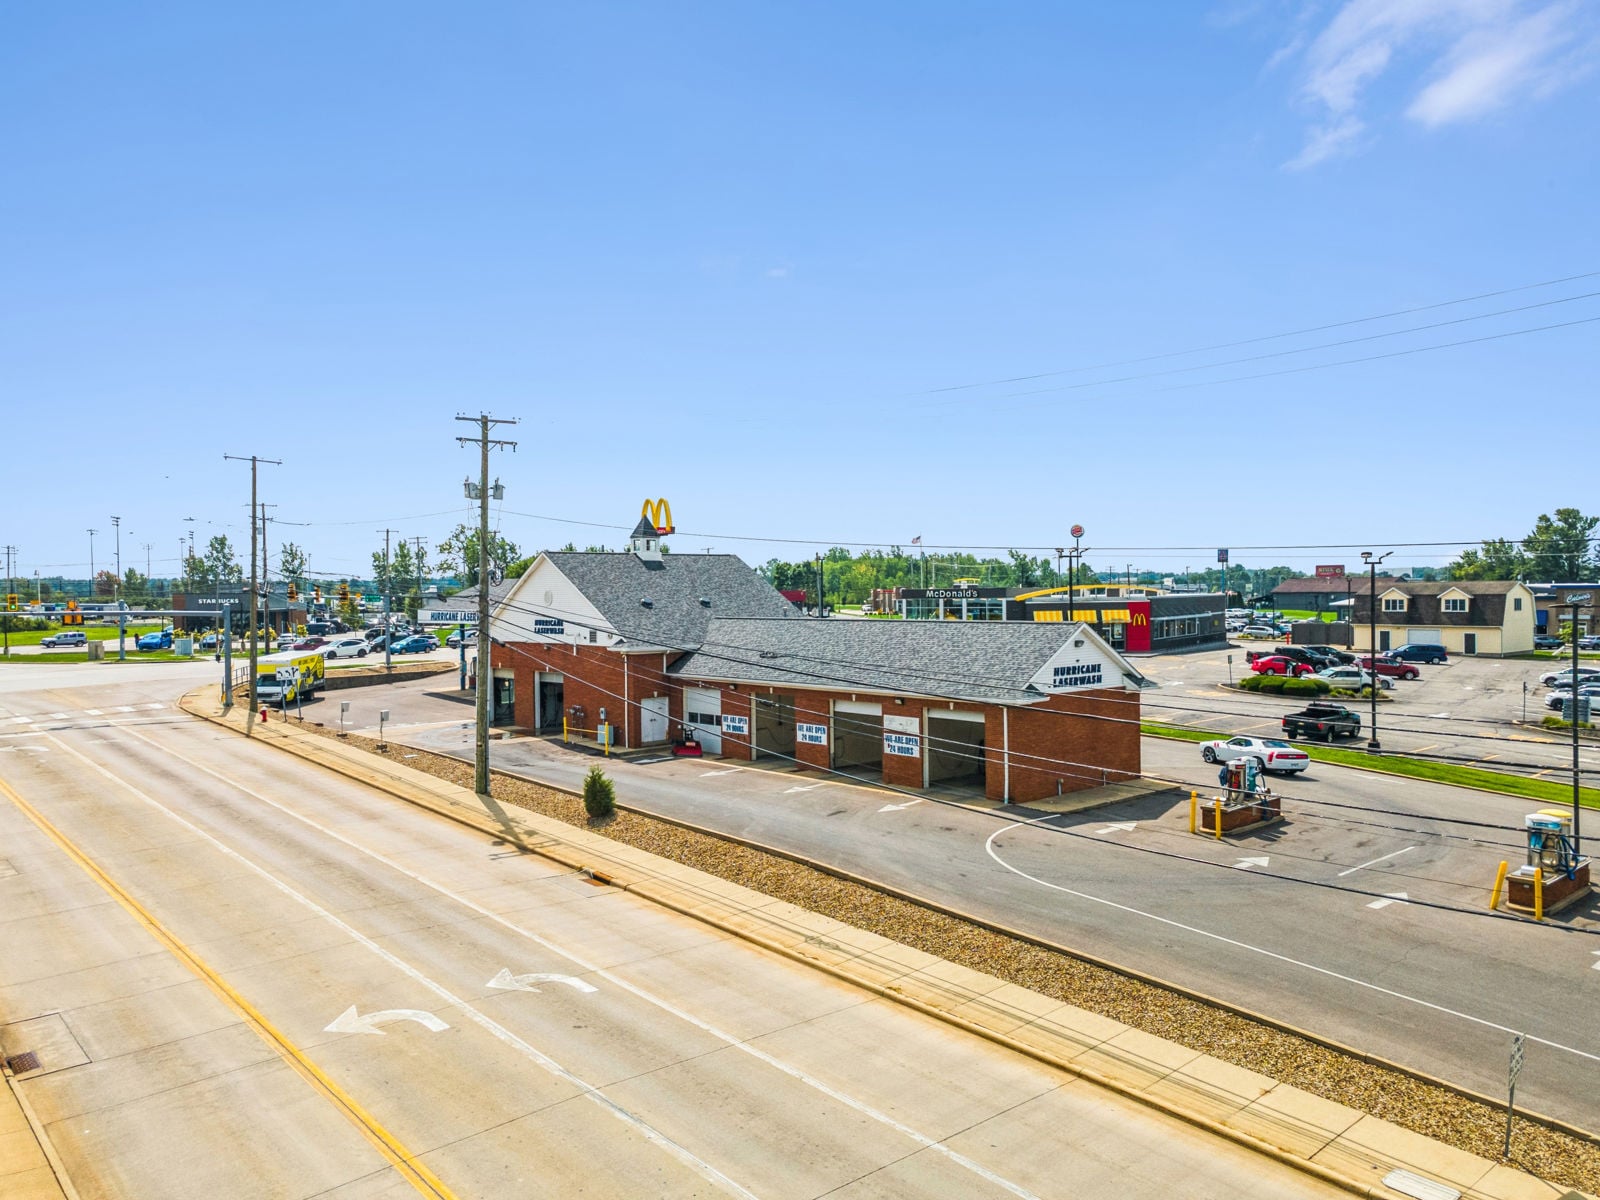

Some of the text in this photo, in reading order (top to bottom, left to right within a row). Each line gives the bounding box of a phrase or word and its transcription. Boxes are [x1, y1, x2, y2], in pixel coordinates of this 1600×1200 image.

[926, 590, 978, 598] McDonald's
[430, 611, 480, 622] HURRICANE LASER
[1053, 664, 1101, 677] HURRICANE
[1053, 675, 1102, 688] LASERWASH
[815, 727, 825, 735] OPEN
[808, 735, 822, 743] HOURS
[885, 735, 893, 743] WE
[905, 737, 918, 746] OPEN
[890, 745, 913, 755] 24 HOURS
